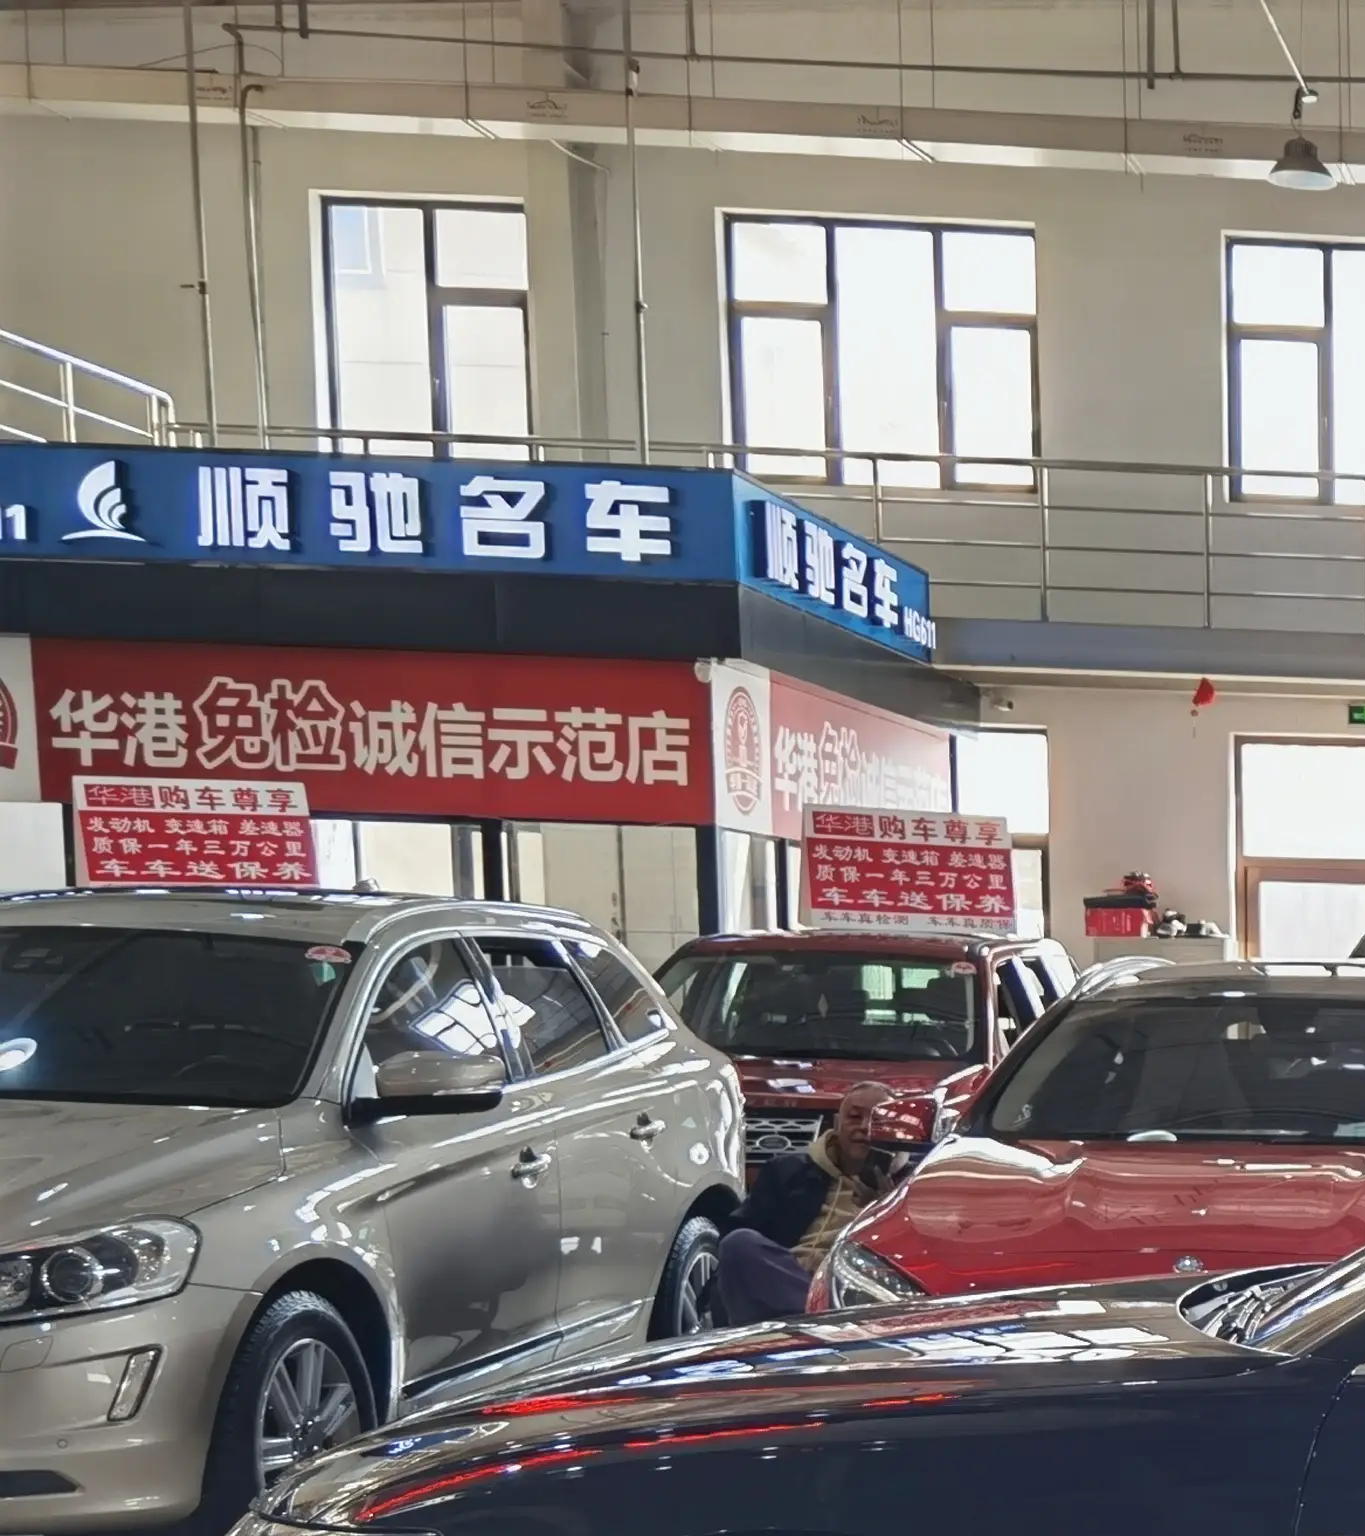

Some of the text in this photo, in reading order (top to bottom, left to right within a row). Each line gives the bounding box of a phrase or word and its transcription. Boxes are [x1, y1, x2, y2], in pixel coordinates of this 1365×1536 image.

[198, 466, 671, 562] 顺驰名车
[765, 501, 936, 650] 顺驰名车 HG611
[49, 676, 691, 787] 华港免检诚信示范店
[87, 784, 300, 813] 华港购车尊享
[87, 817, 305, 837] 发动机 变速箱 差速器
[815, 812, 1004, 846] 华港购车尊享
[92, 836, 308, 858] 质保一年三万公里
[812, 844, 1008, 871] 发动机 变速箱 差速器
[96, 858, 312, 881] 车车送保养
[815, 863, 1008, 891] 质保一年三万公里
[817, 886, 1011, 914] 车车送保养
